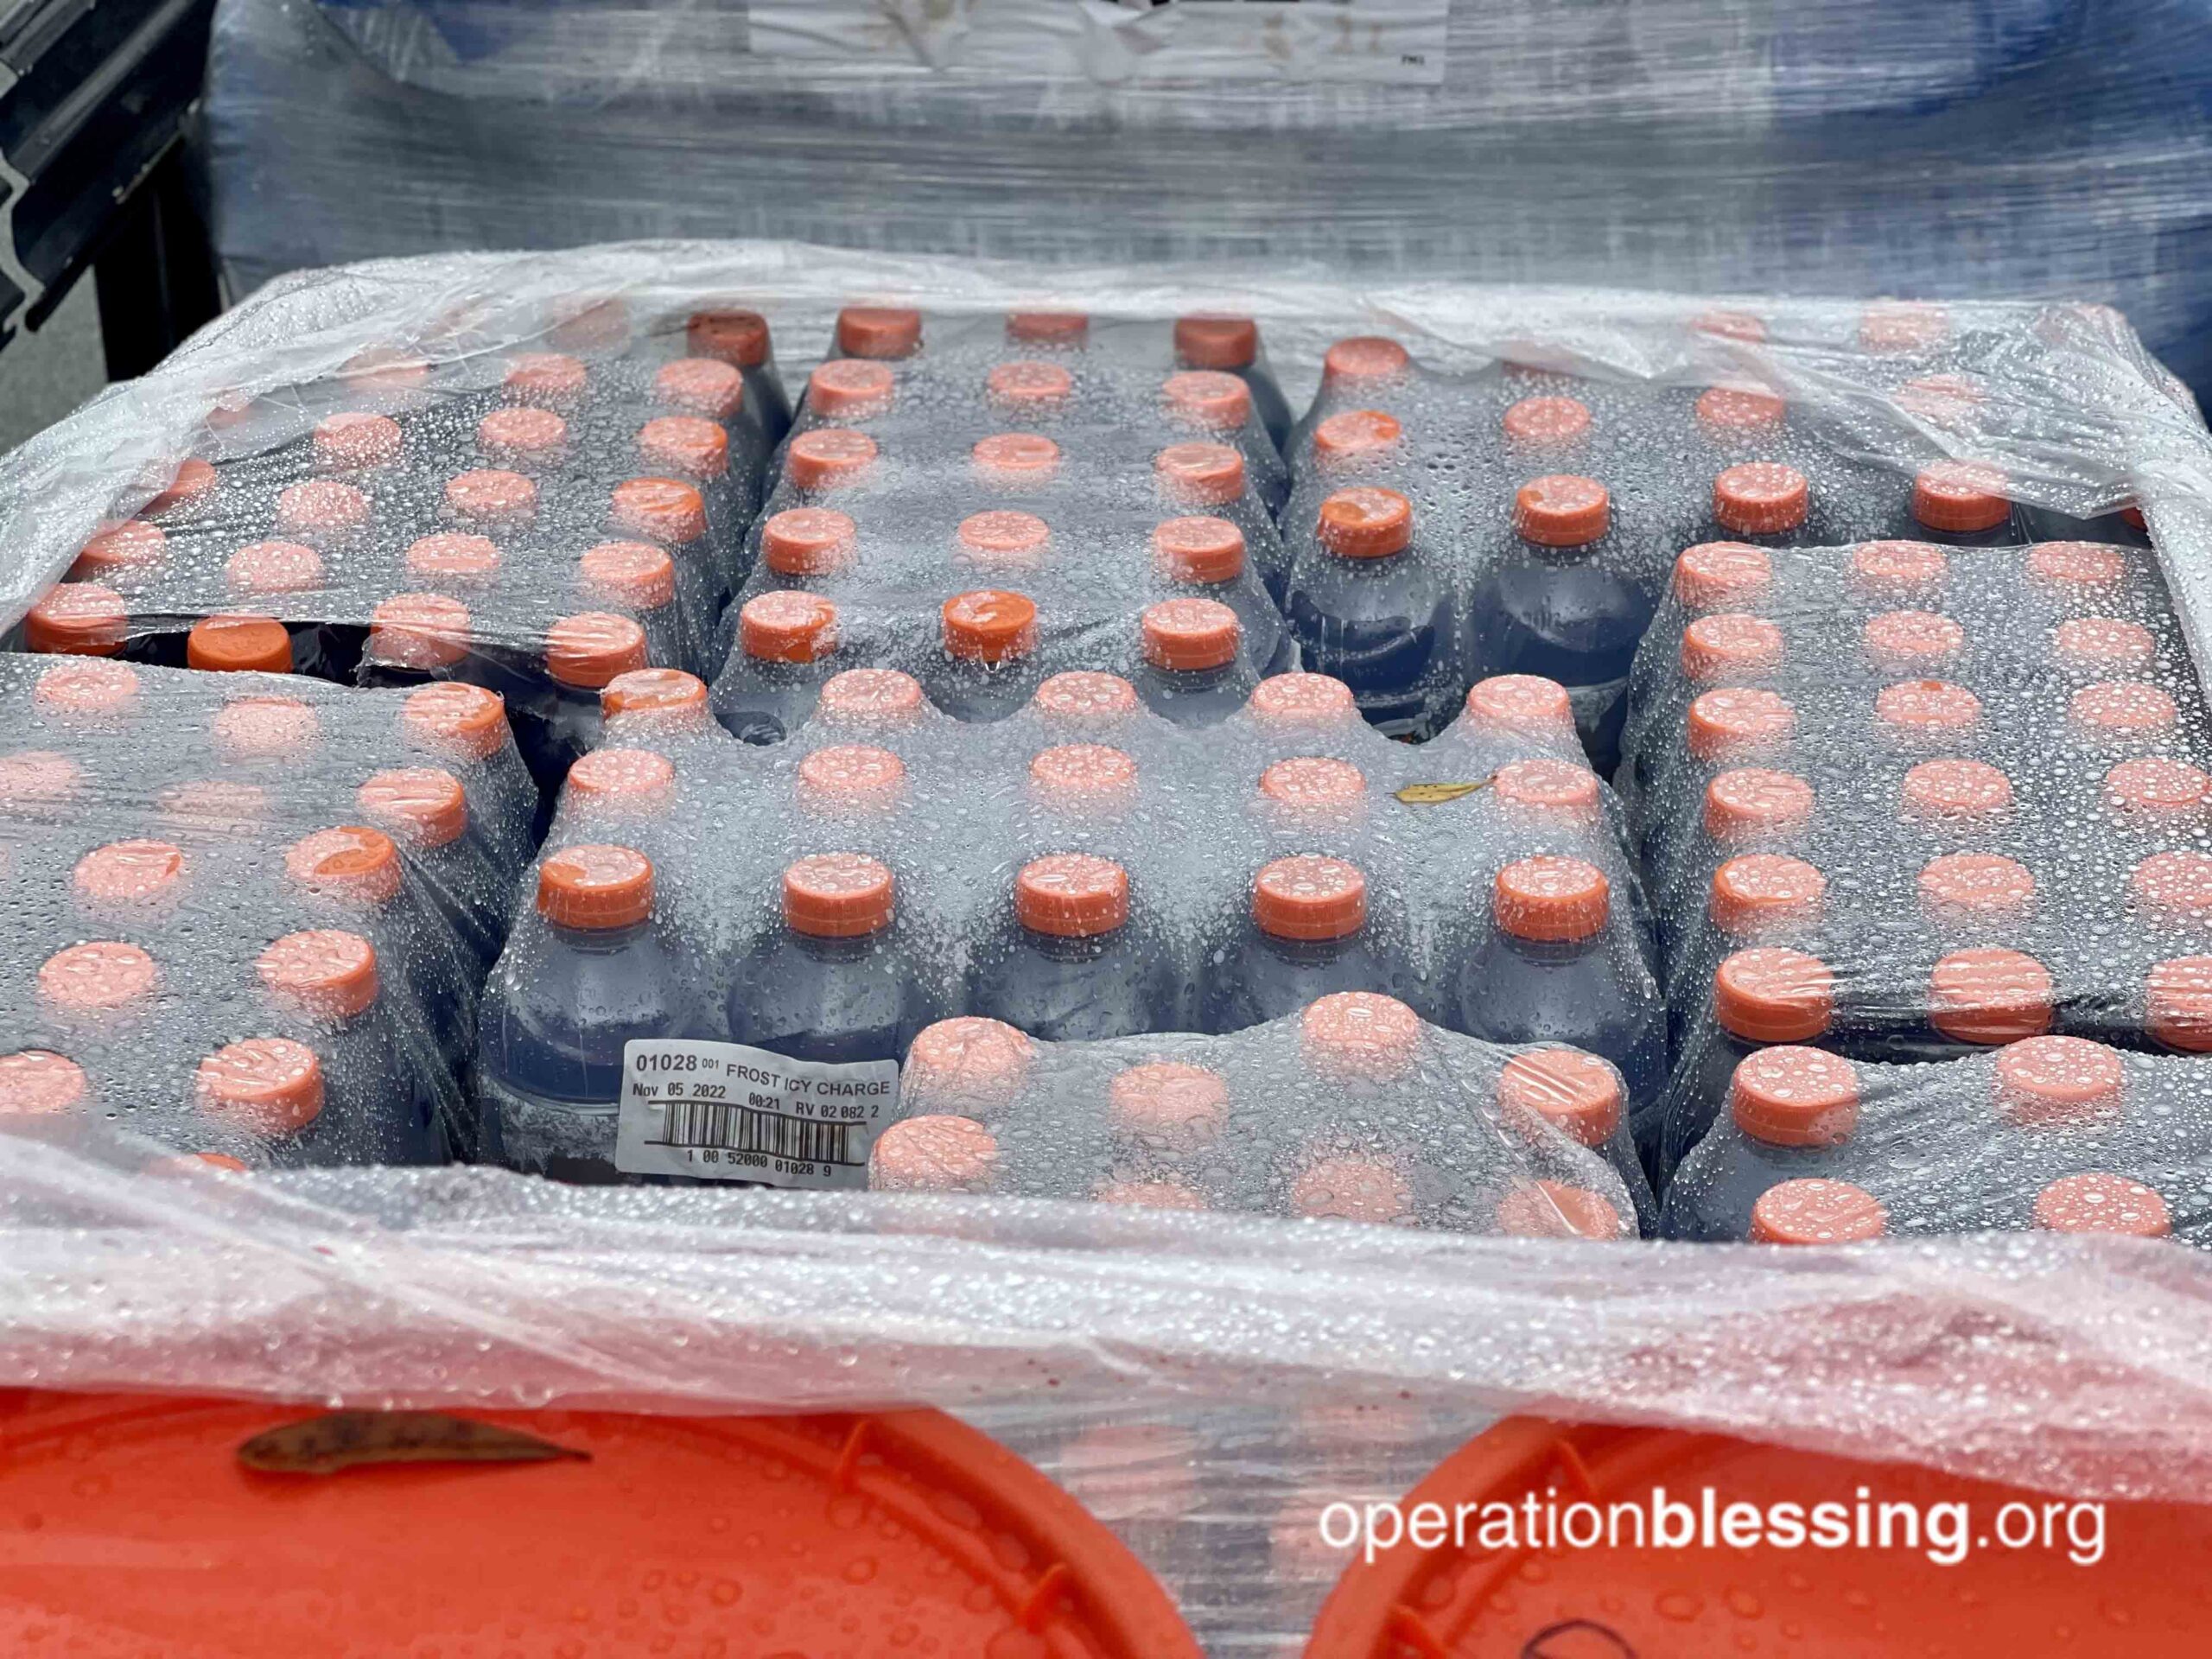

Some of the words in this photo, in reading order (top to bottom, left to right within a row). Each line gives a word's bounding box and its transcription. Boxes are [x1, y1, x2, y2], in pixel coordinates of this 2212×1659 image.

[636, 1054, 697, 1071] 01028
[702, 1058, 719, 1070] 001
[726, 1064, 781, 1088] FROST
[784, 1077, 812, 1093] ICY
[817, 1080, 891, 1096] CHARGE
[632, 1083, 658, 1096] Nov
[667, 1082, 683, 1096] 05
[692, 1084, 727, 1099] 2022
[748, 1091, 780, 1110] 00:21
[796, 1101, 816, 1116] RV
[870, 1104, 880, 1118] 2
[687, 1150, 693, 1163] 1
[702, 1150, 719, 1164] 00
[728, 1150, 768, 1167] 52000
[774, 1160, 814, 1175] 01028
[823, 1165, 832, 1177] 9
